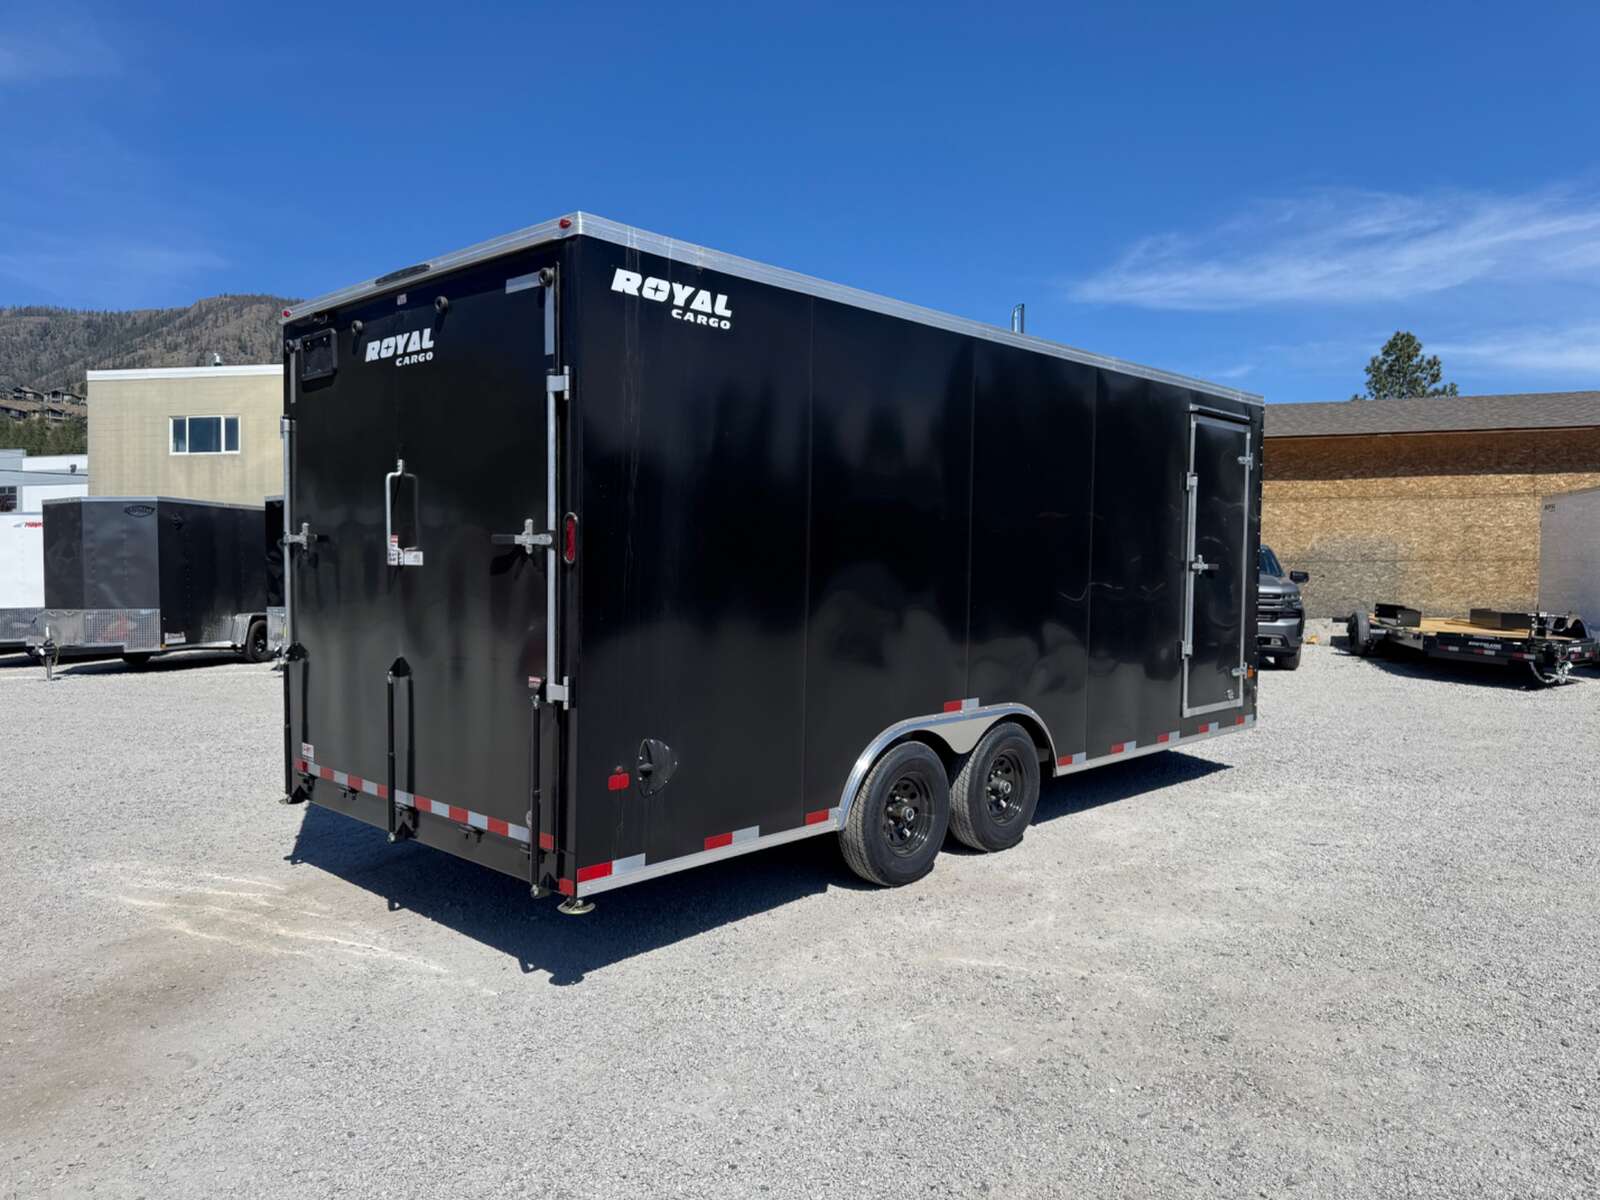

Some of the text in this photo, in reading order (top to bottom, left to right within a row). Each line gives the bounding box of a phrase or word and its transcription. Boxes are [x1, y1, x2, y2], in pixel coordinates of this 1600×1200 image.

[611, 268, 732, 318] ROYAL
[671, 309, 731, 330] CARGO
[365, 328, 434, 363] ROYAL
[396, 352, 434, 367] CARGO
